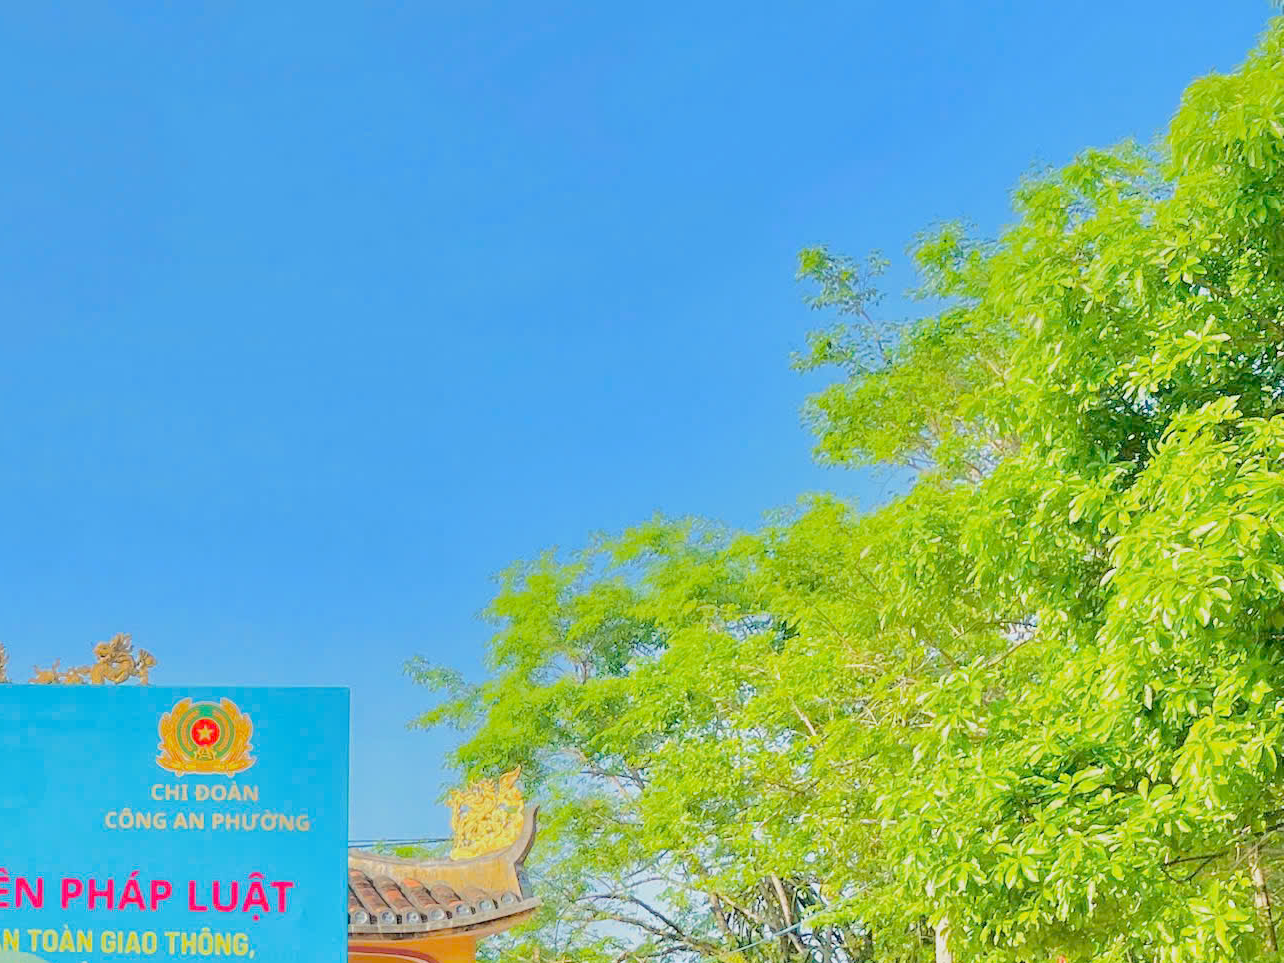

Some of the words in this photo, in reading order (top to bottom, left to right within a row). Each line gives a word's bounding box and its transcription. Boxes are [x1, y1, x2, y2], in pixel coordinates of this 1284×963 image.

[150, 783, 189, 801] CHI
[195, 781, 259, 802] ĐOÀN
[104, 807, 167, 830] CÔNG
[173, 811, 205, 830] AN
[211, 810, 311, 832] PHƯỜNG
[61, 870, 173, 911] PHÁP
[188, 871, 295, 921] LUẬT
[27, 923, 93, 953] TOÀN
[101, 931, 157, 954] GIAO
[165, 927, 256, 959] THÔNG,
